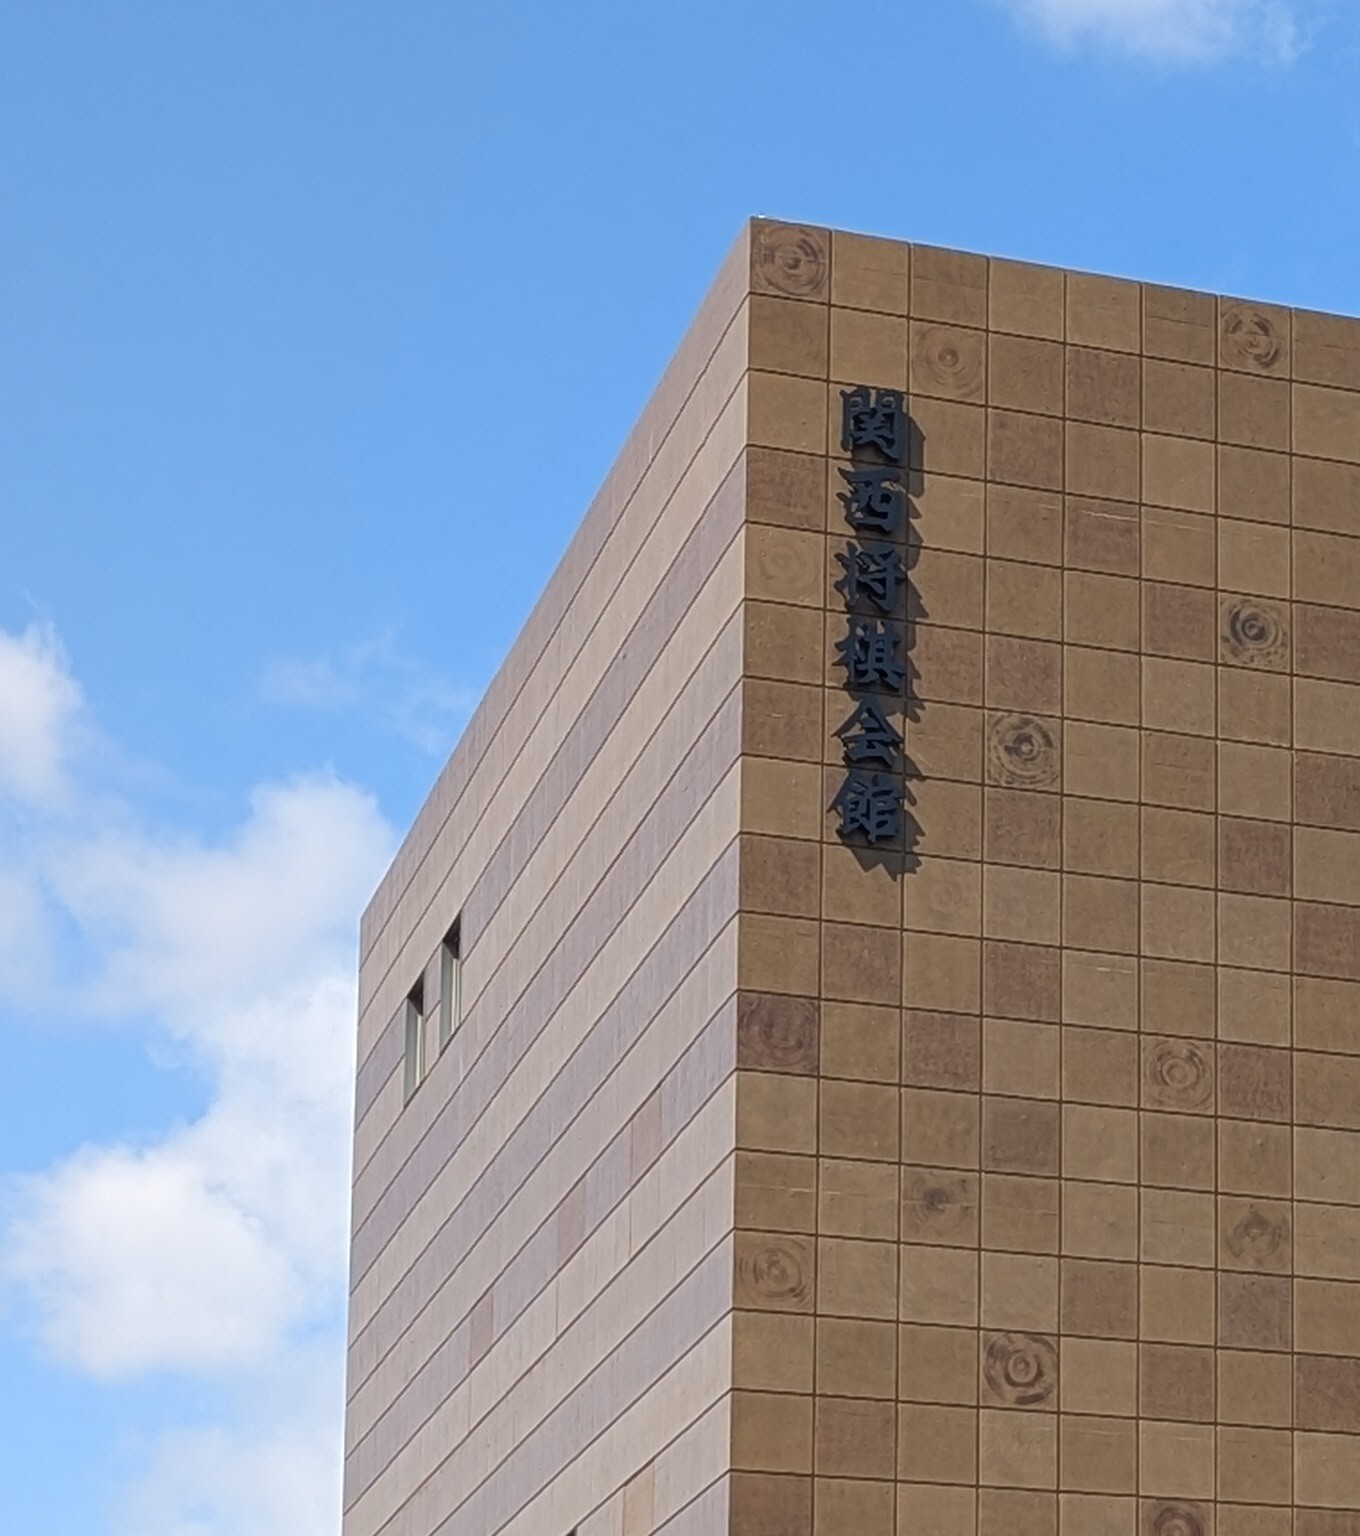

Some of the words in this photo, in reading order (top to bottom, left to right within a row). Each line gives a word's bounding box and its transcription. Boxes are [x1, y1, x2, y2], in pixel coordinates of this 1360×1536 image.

[829, 388, 906, 843] 関西将棋会館
